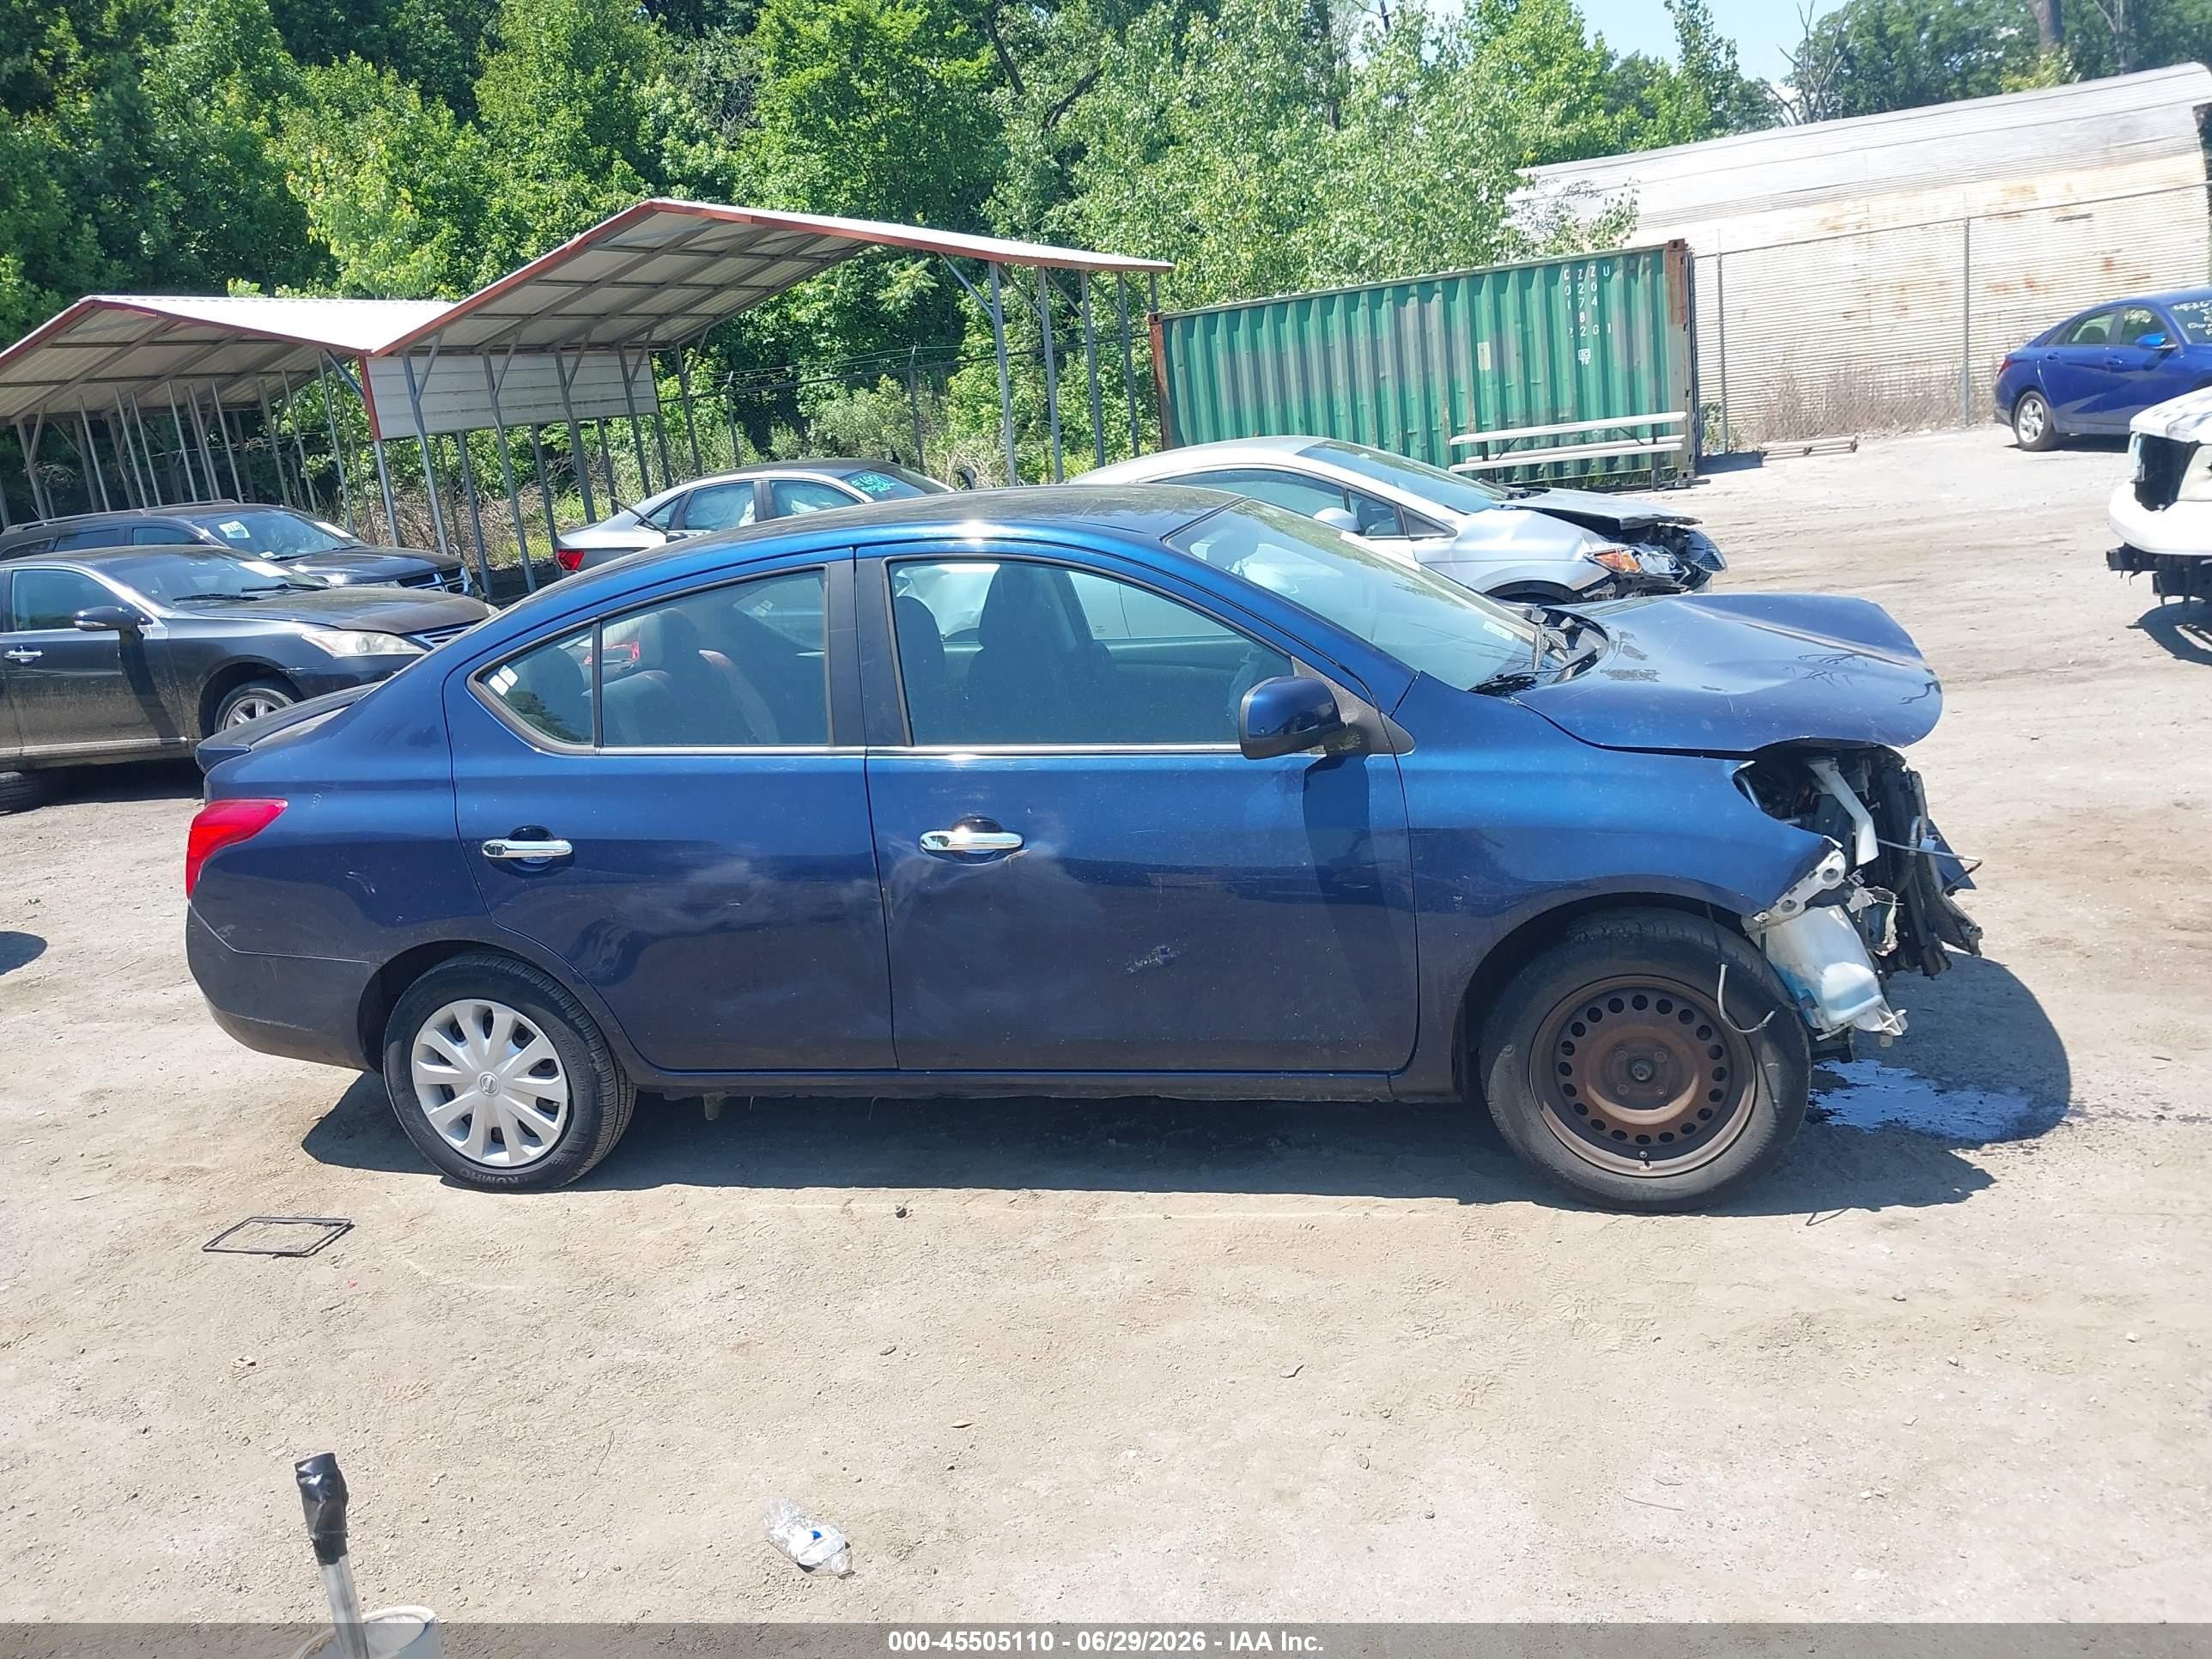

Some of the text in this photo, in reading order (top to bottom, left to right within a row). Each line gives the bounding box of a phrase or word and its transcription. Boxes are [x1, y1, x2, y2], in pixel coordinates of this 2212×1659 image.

[1564, 265, 1610, 280] CZZU
[1565, 283, 1598, 296] 020
[1567, 295, 1598, 310] 174
[1579, 311, 1586, 323] 8
